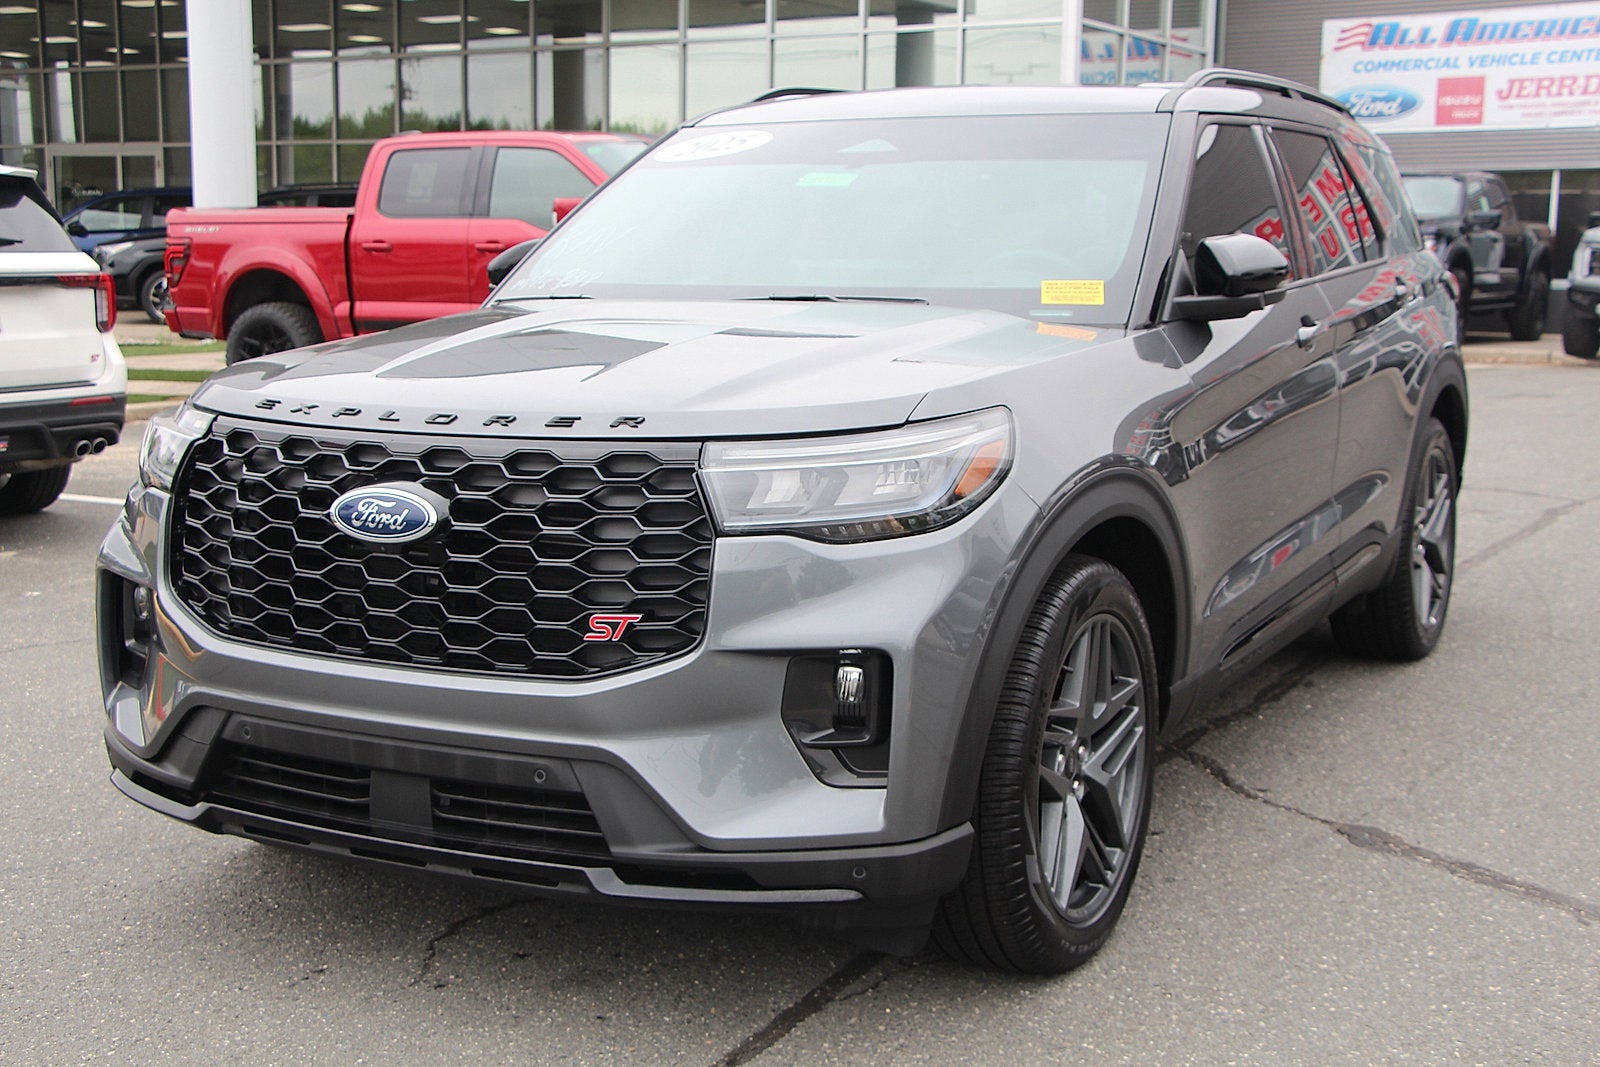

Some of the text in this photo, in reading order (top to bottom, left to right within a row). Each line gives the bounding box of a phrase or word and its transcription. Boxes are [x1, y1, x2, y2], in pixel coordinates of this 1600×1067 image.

[1365, 21, 1438, 47] ALL
[1352, 56, 1460, 74] COMMERCIAL
[1467, 51, 1541, 69] VEHICLE
[1344, 90, 1404, 117] Ford
[255, 398, 646, 429] EXPLORER
[351, 498, 410, 530] Ford
[583, 613, 644, 641] ST
